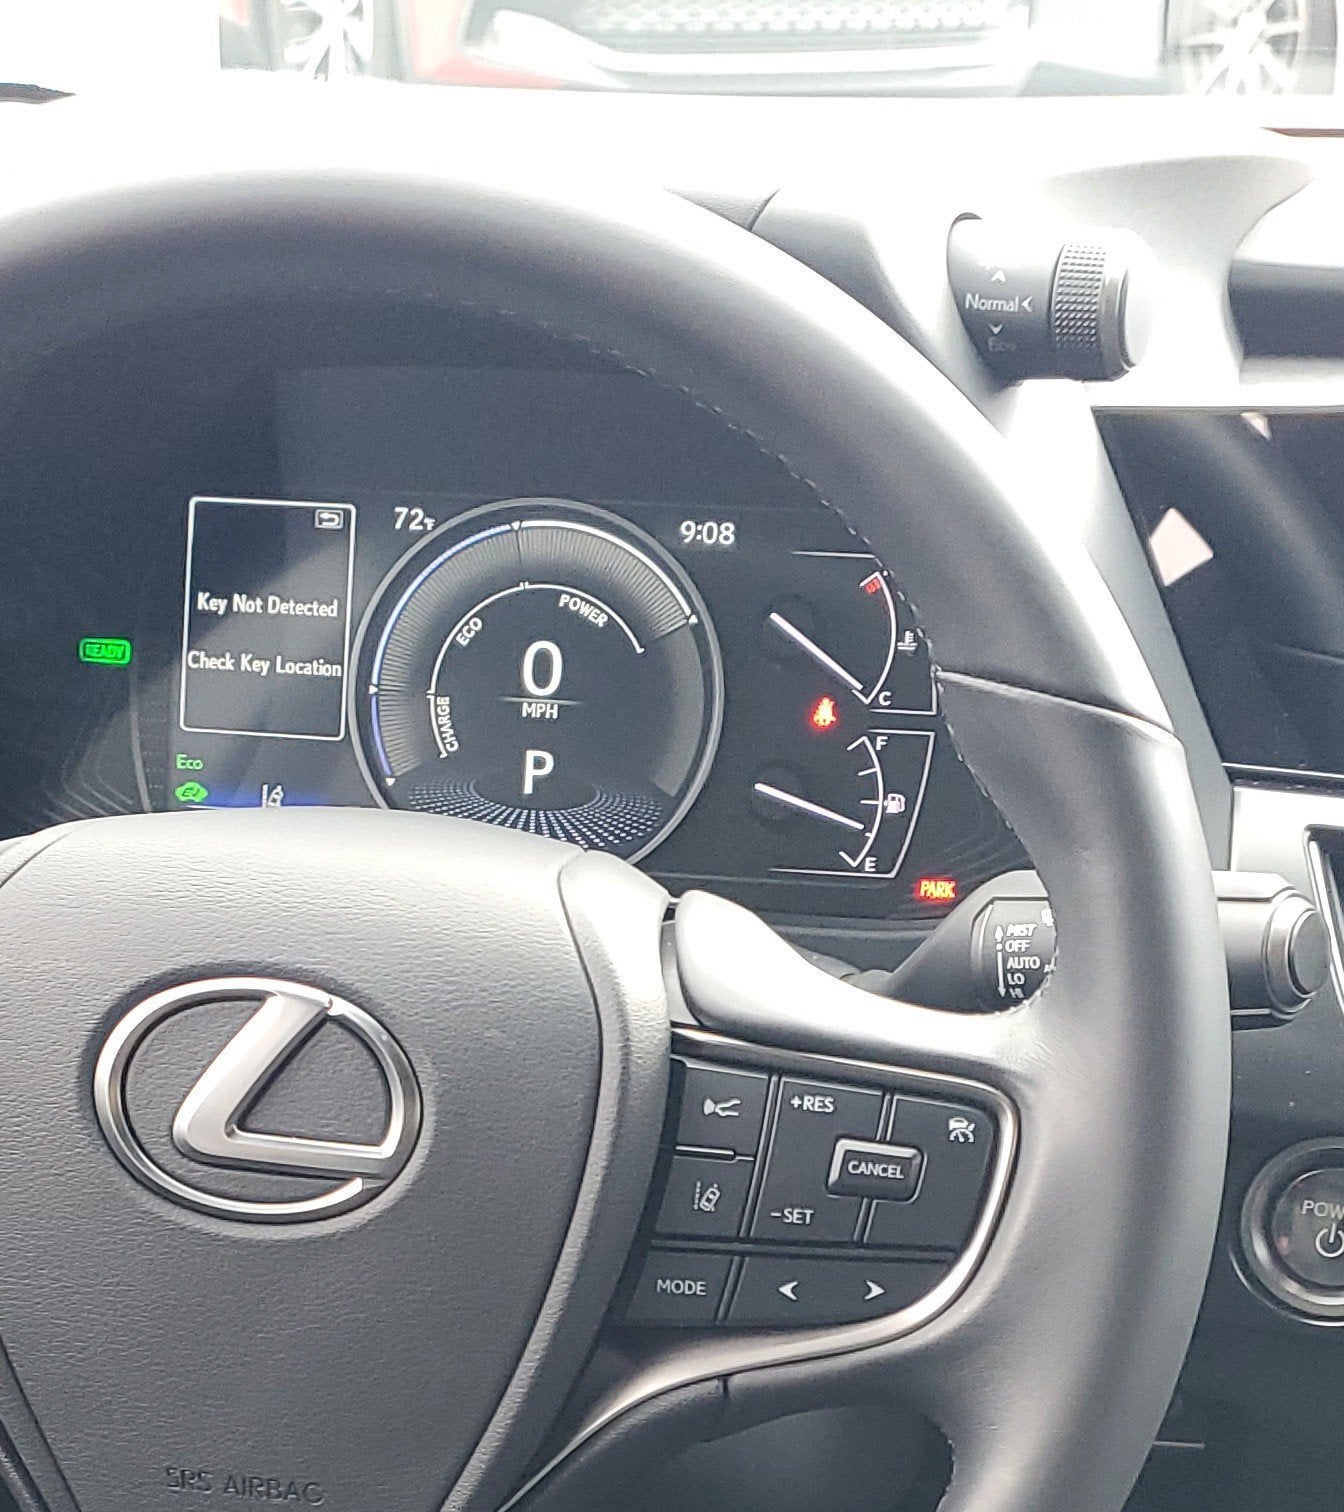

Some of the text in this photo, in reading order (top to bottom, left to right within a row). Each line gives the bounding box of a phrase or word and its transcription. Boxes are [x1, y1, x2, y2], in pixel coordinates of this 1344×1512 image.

[964, 293, 1020, 314] Normal
[679, 520, 736, 546] 9:08
[197, 592, 339, 618] Key Not Detected
[558, 593, 609, 628] POWER
[455, 617, 483, 647] ECO
[187, 650, 342, 677] Check Key Location
[522, 640, 563, 697] 0
[521, 702, 558, 719] MPH
[436, 696, 460, 752] CHARGE
[875, 736, 889, 750] F
[176, 754, 204, 769] Eco
[522, 750, 554, 795] P
[864, 857, 878, 872] E
[919, 880, 956, 899] PARK
[1004, 940, 1032, 953] OFF
[1006, 956, 1041, 970] AUTO
[1006, 972, 1025, 985] LO
[847, 1160, 905, 1180] CANCEL
[656, 1279, 707, 1297] MODE
[164, 1466, 324, 1506] SRS AIRBAG
